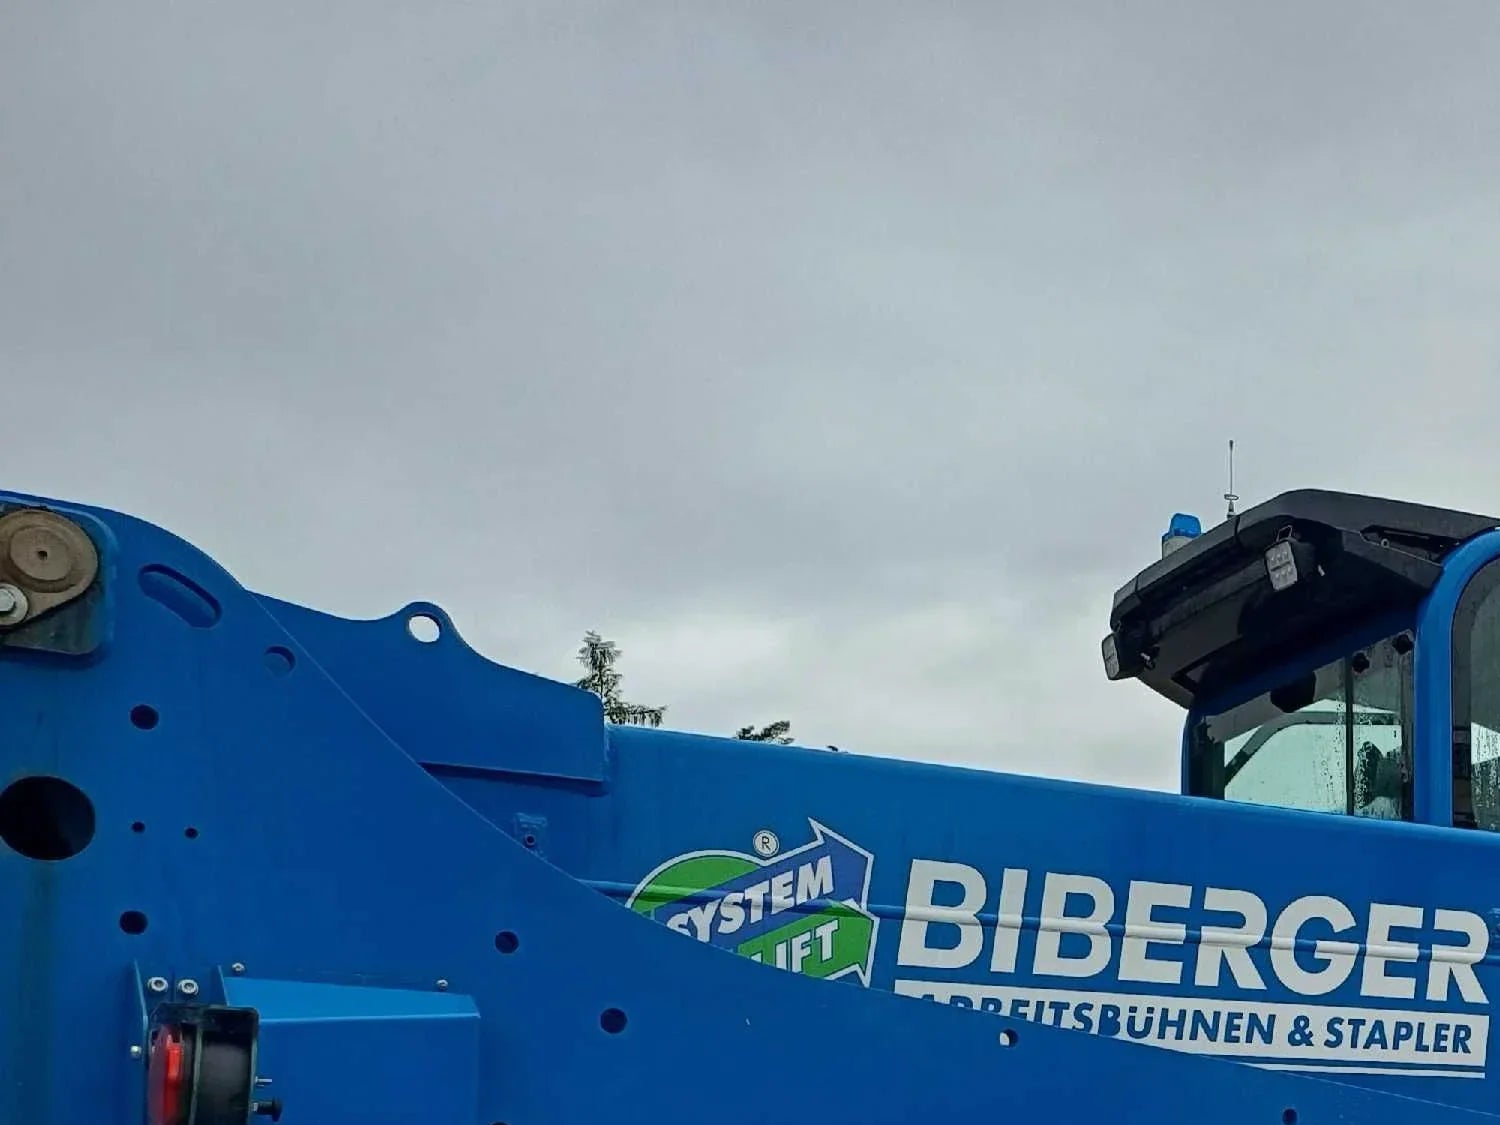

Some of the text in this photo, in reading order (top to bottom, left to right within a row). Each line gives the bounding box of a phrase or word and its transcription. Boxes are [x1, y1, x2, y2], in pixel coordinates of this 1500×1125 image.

[750, 920, 838, 973] IFT
[898, 859, 1490, 1004] BIBERGER
[919, 994, 1472, 1054] EITSBÜHNEN & STAPLER
